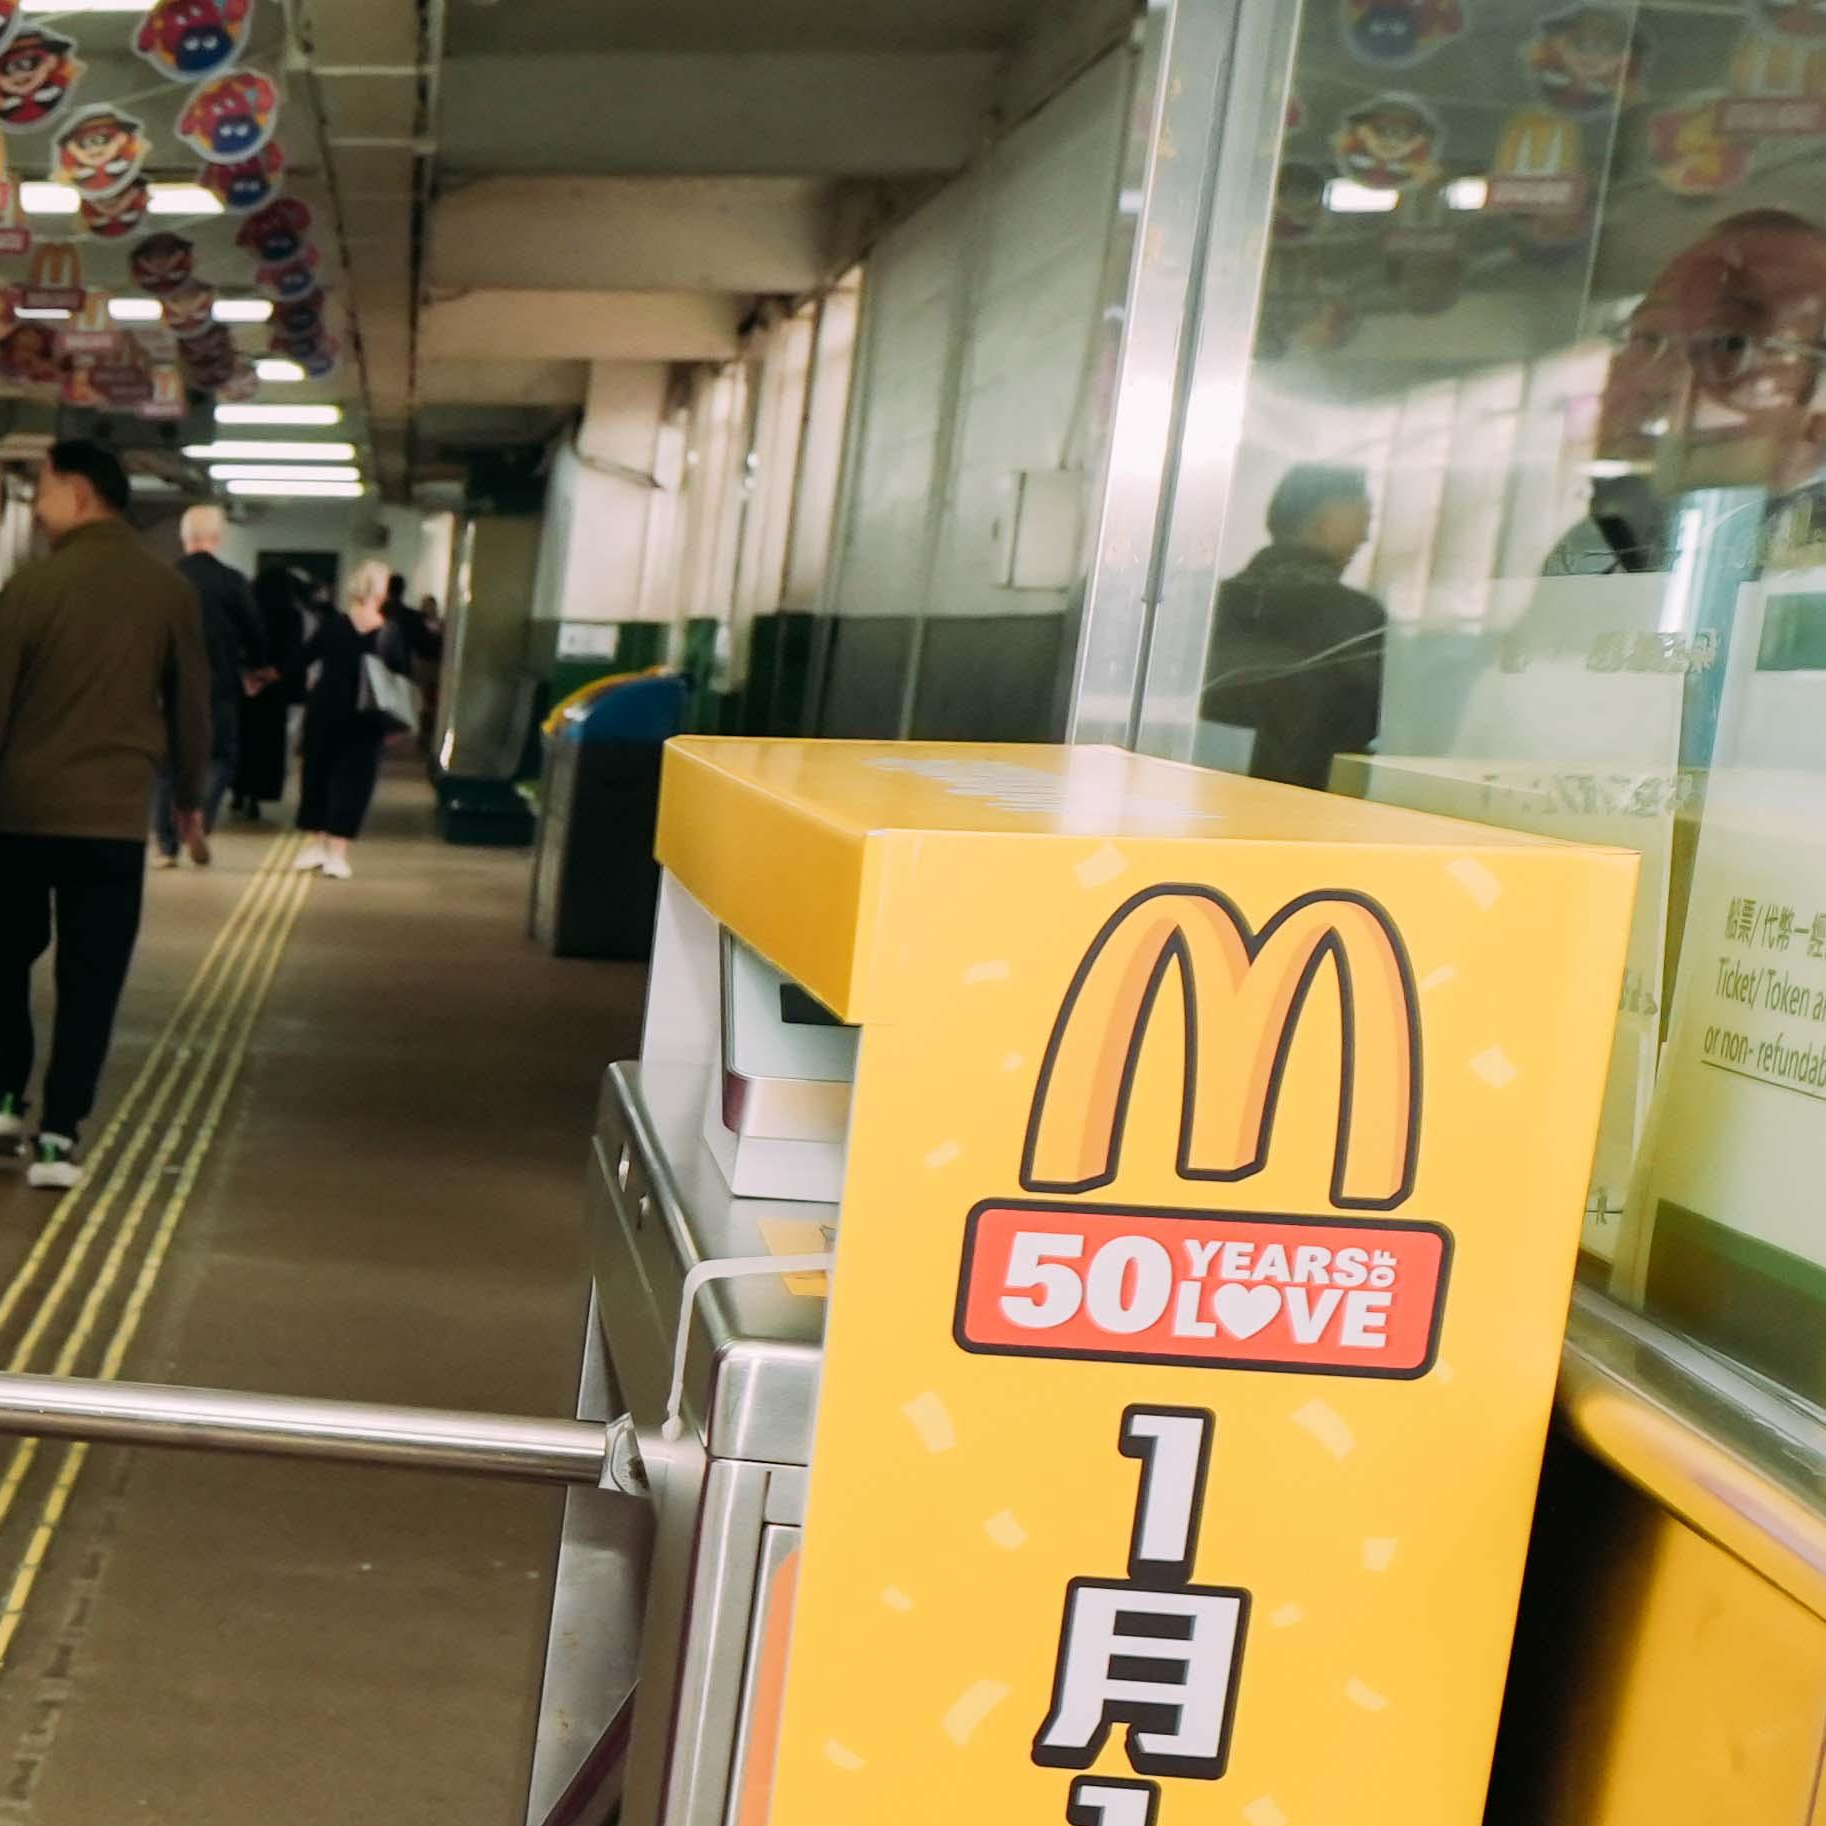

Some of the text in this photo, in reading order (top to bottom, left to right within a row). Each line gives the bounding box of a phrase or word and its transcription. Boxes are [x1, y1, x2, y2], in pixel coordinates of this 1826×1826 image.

[1716, 957, 1764, 1010] Ticket/
[1765, 967, 1810, 1017] Token
[1704, 1025, 1720, 1053] or
[1721, 1030, 1753, 1065] non-
[999, 1231, 1398, 1335] 50 YEARS OF
